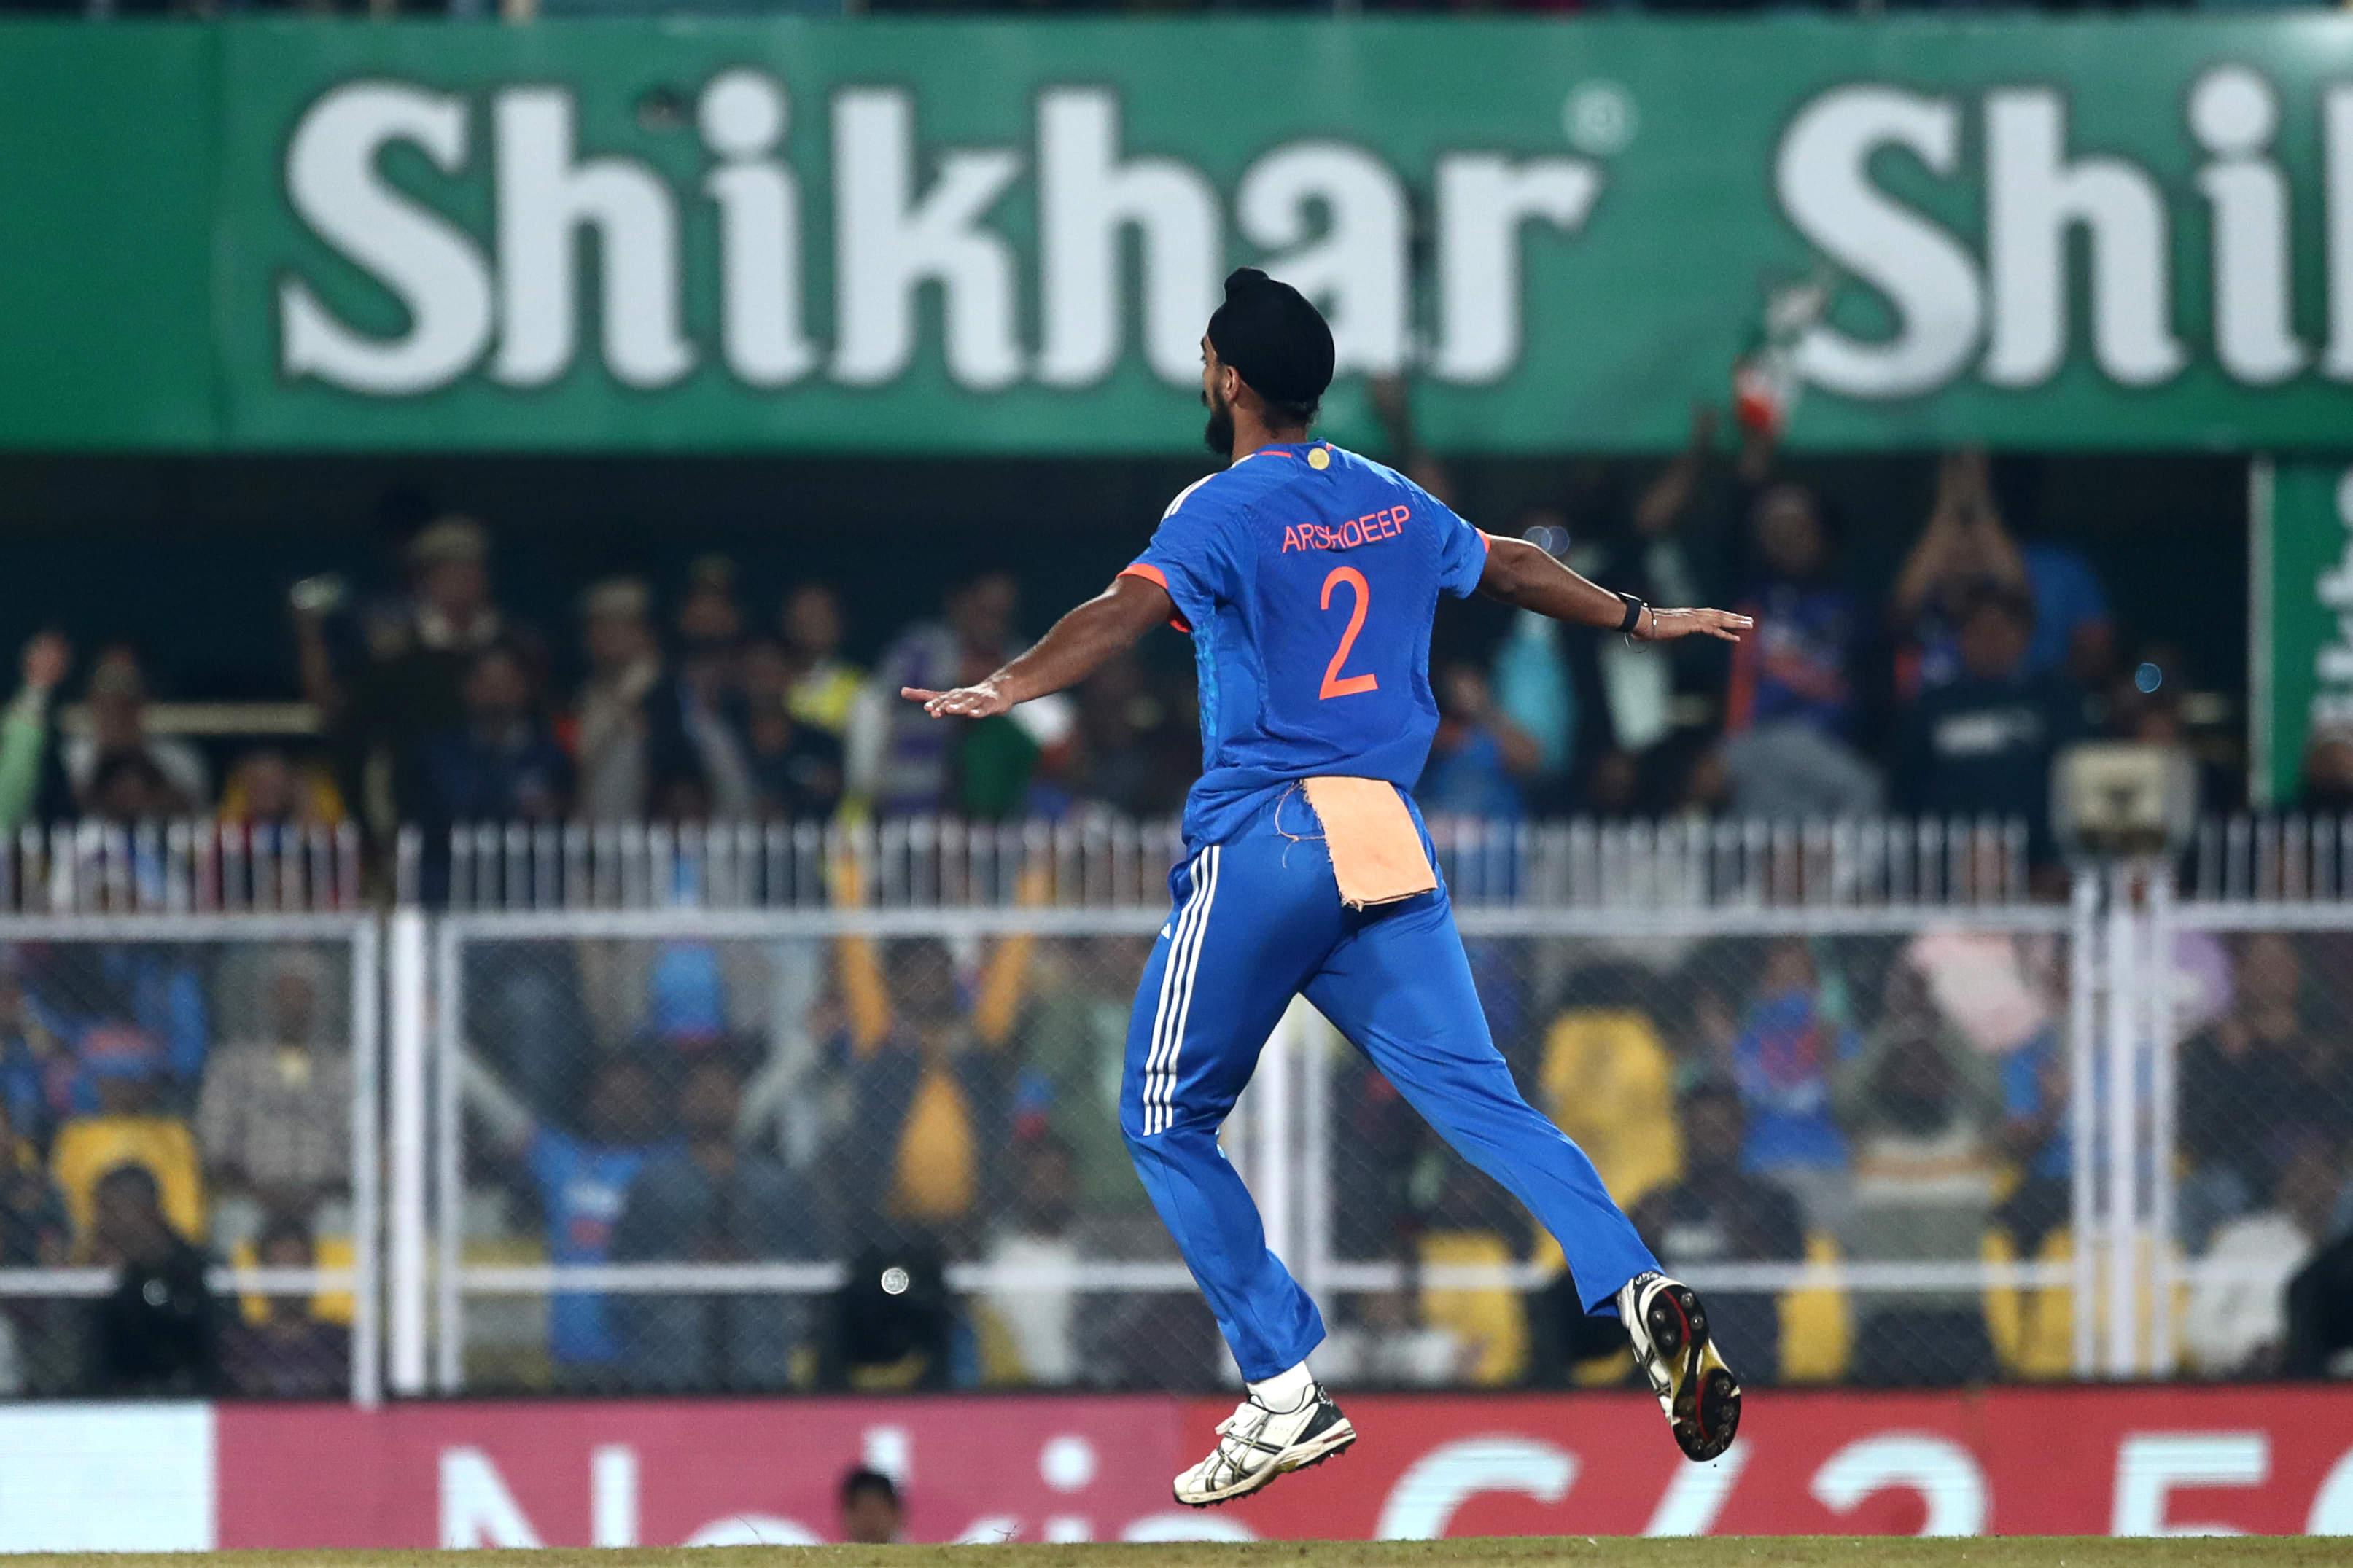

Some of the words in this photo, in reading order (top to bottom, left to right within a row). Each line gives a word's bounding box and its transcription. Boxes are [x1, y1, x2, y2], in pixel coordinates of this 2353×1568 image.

[280, 69, 1601, 395] Shikhar
[1777, 64, 2353, 400] Shi
[1282, 504, 1411, 553] ARSHDEEP
[1318, 566, 1379, 701] 2
